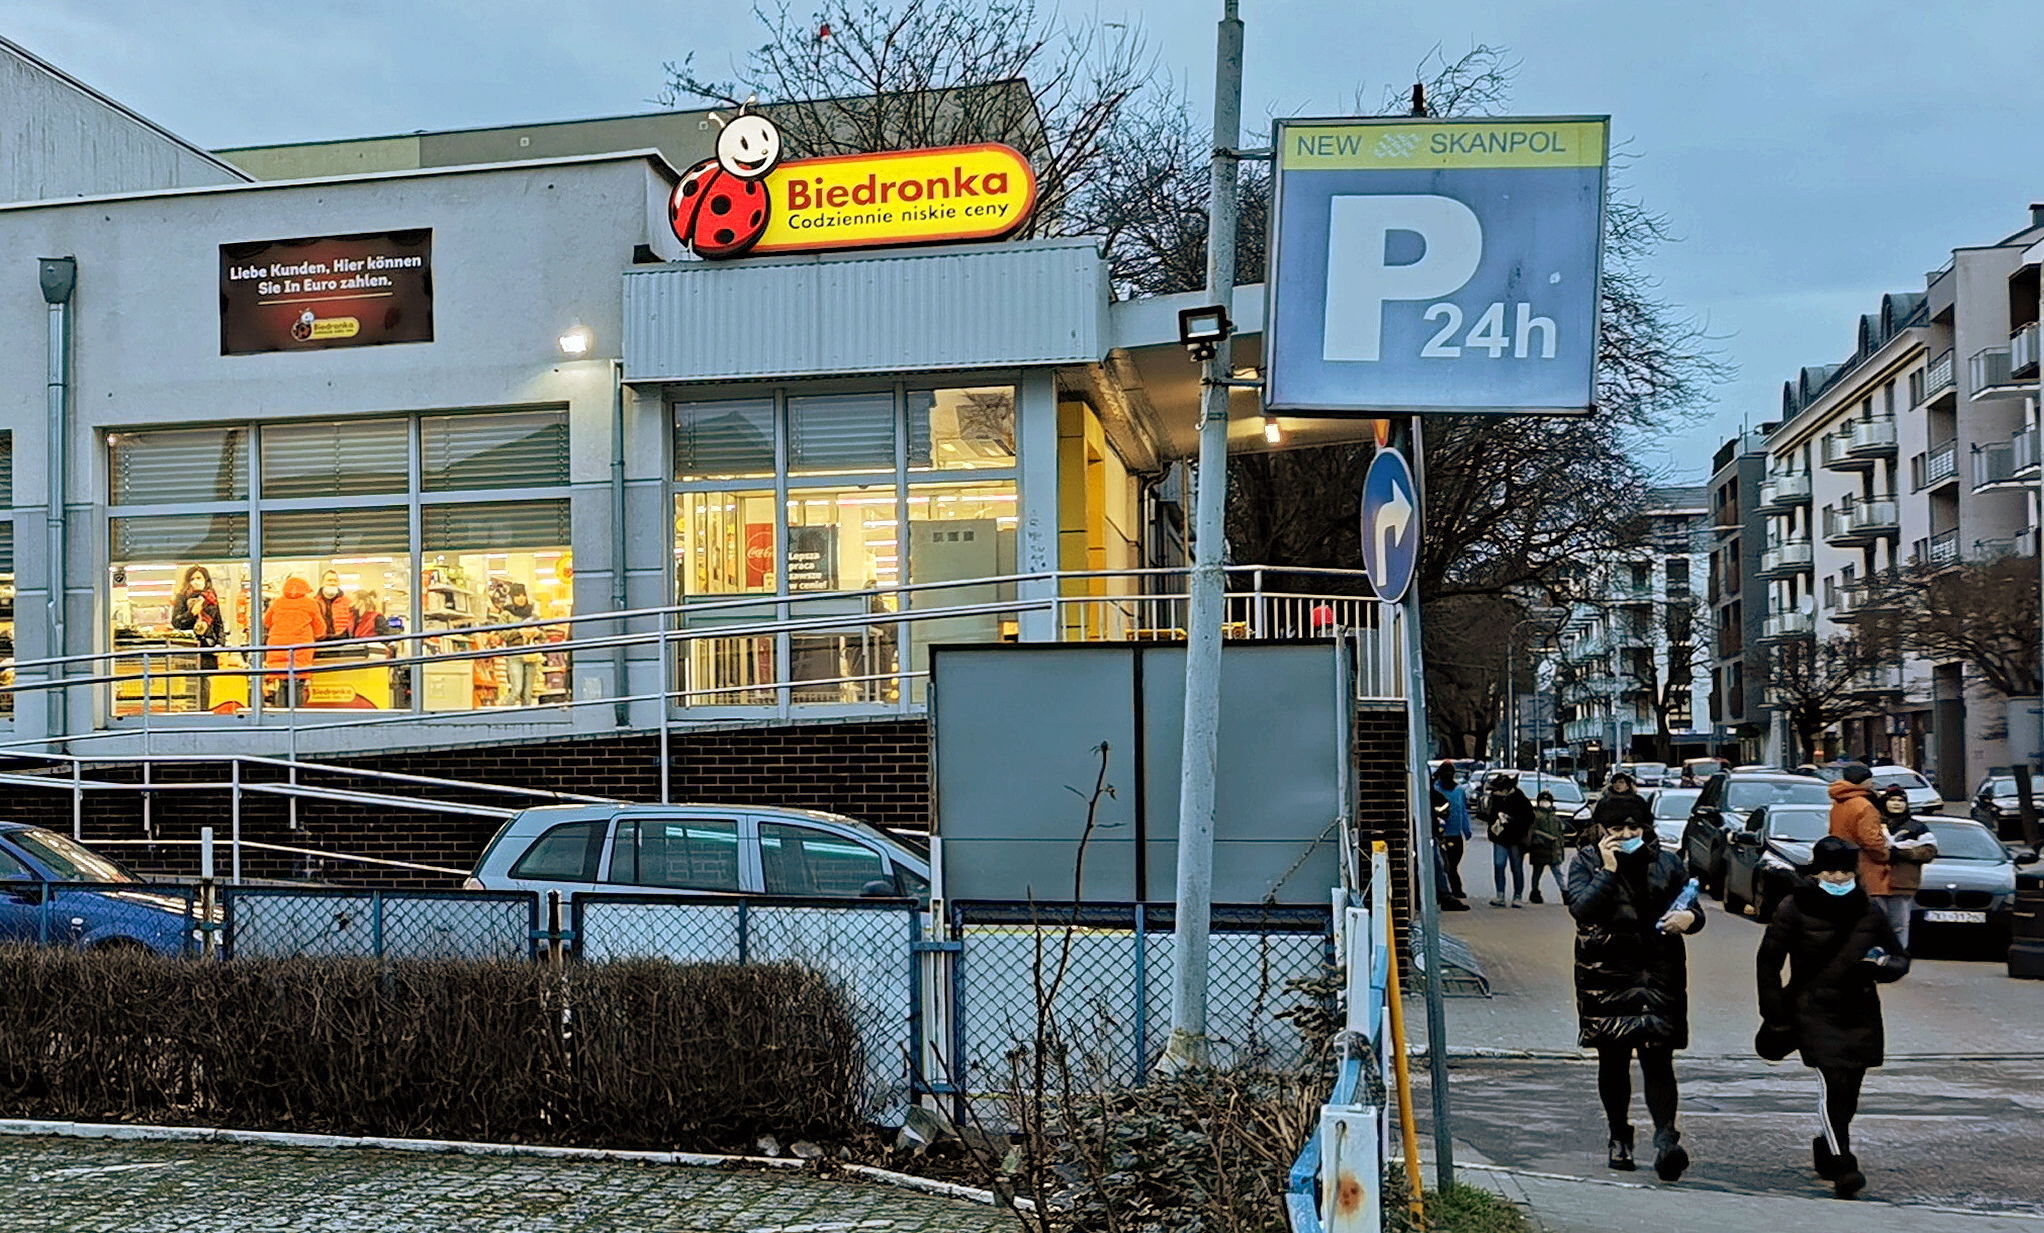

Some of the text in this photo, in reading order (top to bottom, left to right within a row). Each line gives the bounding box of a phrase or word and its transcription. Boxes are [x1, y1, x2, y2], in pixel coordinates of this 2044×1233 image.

[1297, 131, 1567, 156] NEW SKANPOL
[788, 166, 1008, 211] Biedronka
[788, 203, 1009, 230] Codziennie niskie ceny
[230, 255, 422, 280] Liebe Kunden, Hier können
[1323, 194, 1482, 361] P
[258, 272, 393, 295] Sie In Euro zahlen.
[1420, 302, 1557, 358] 24h
